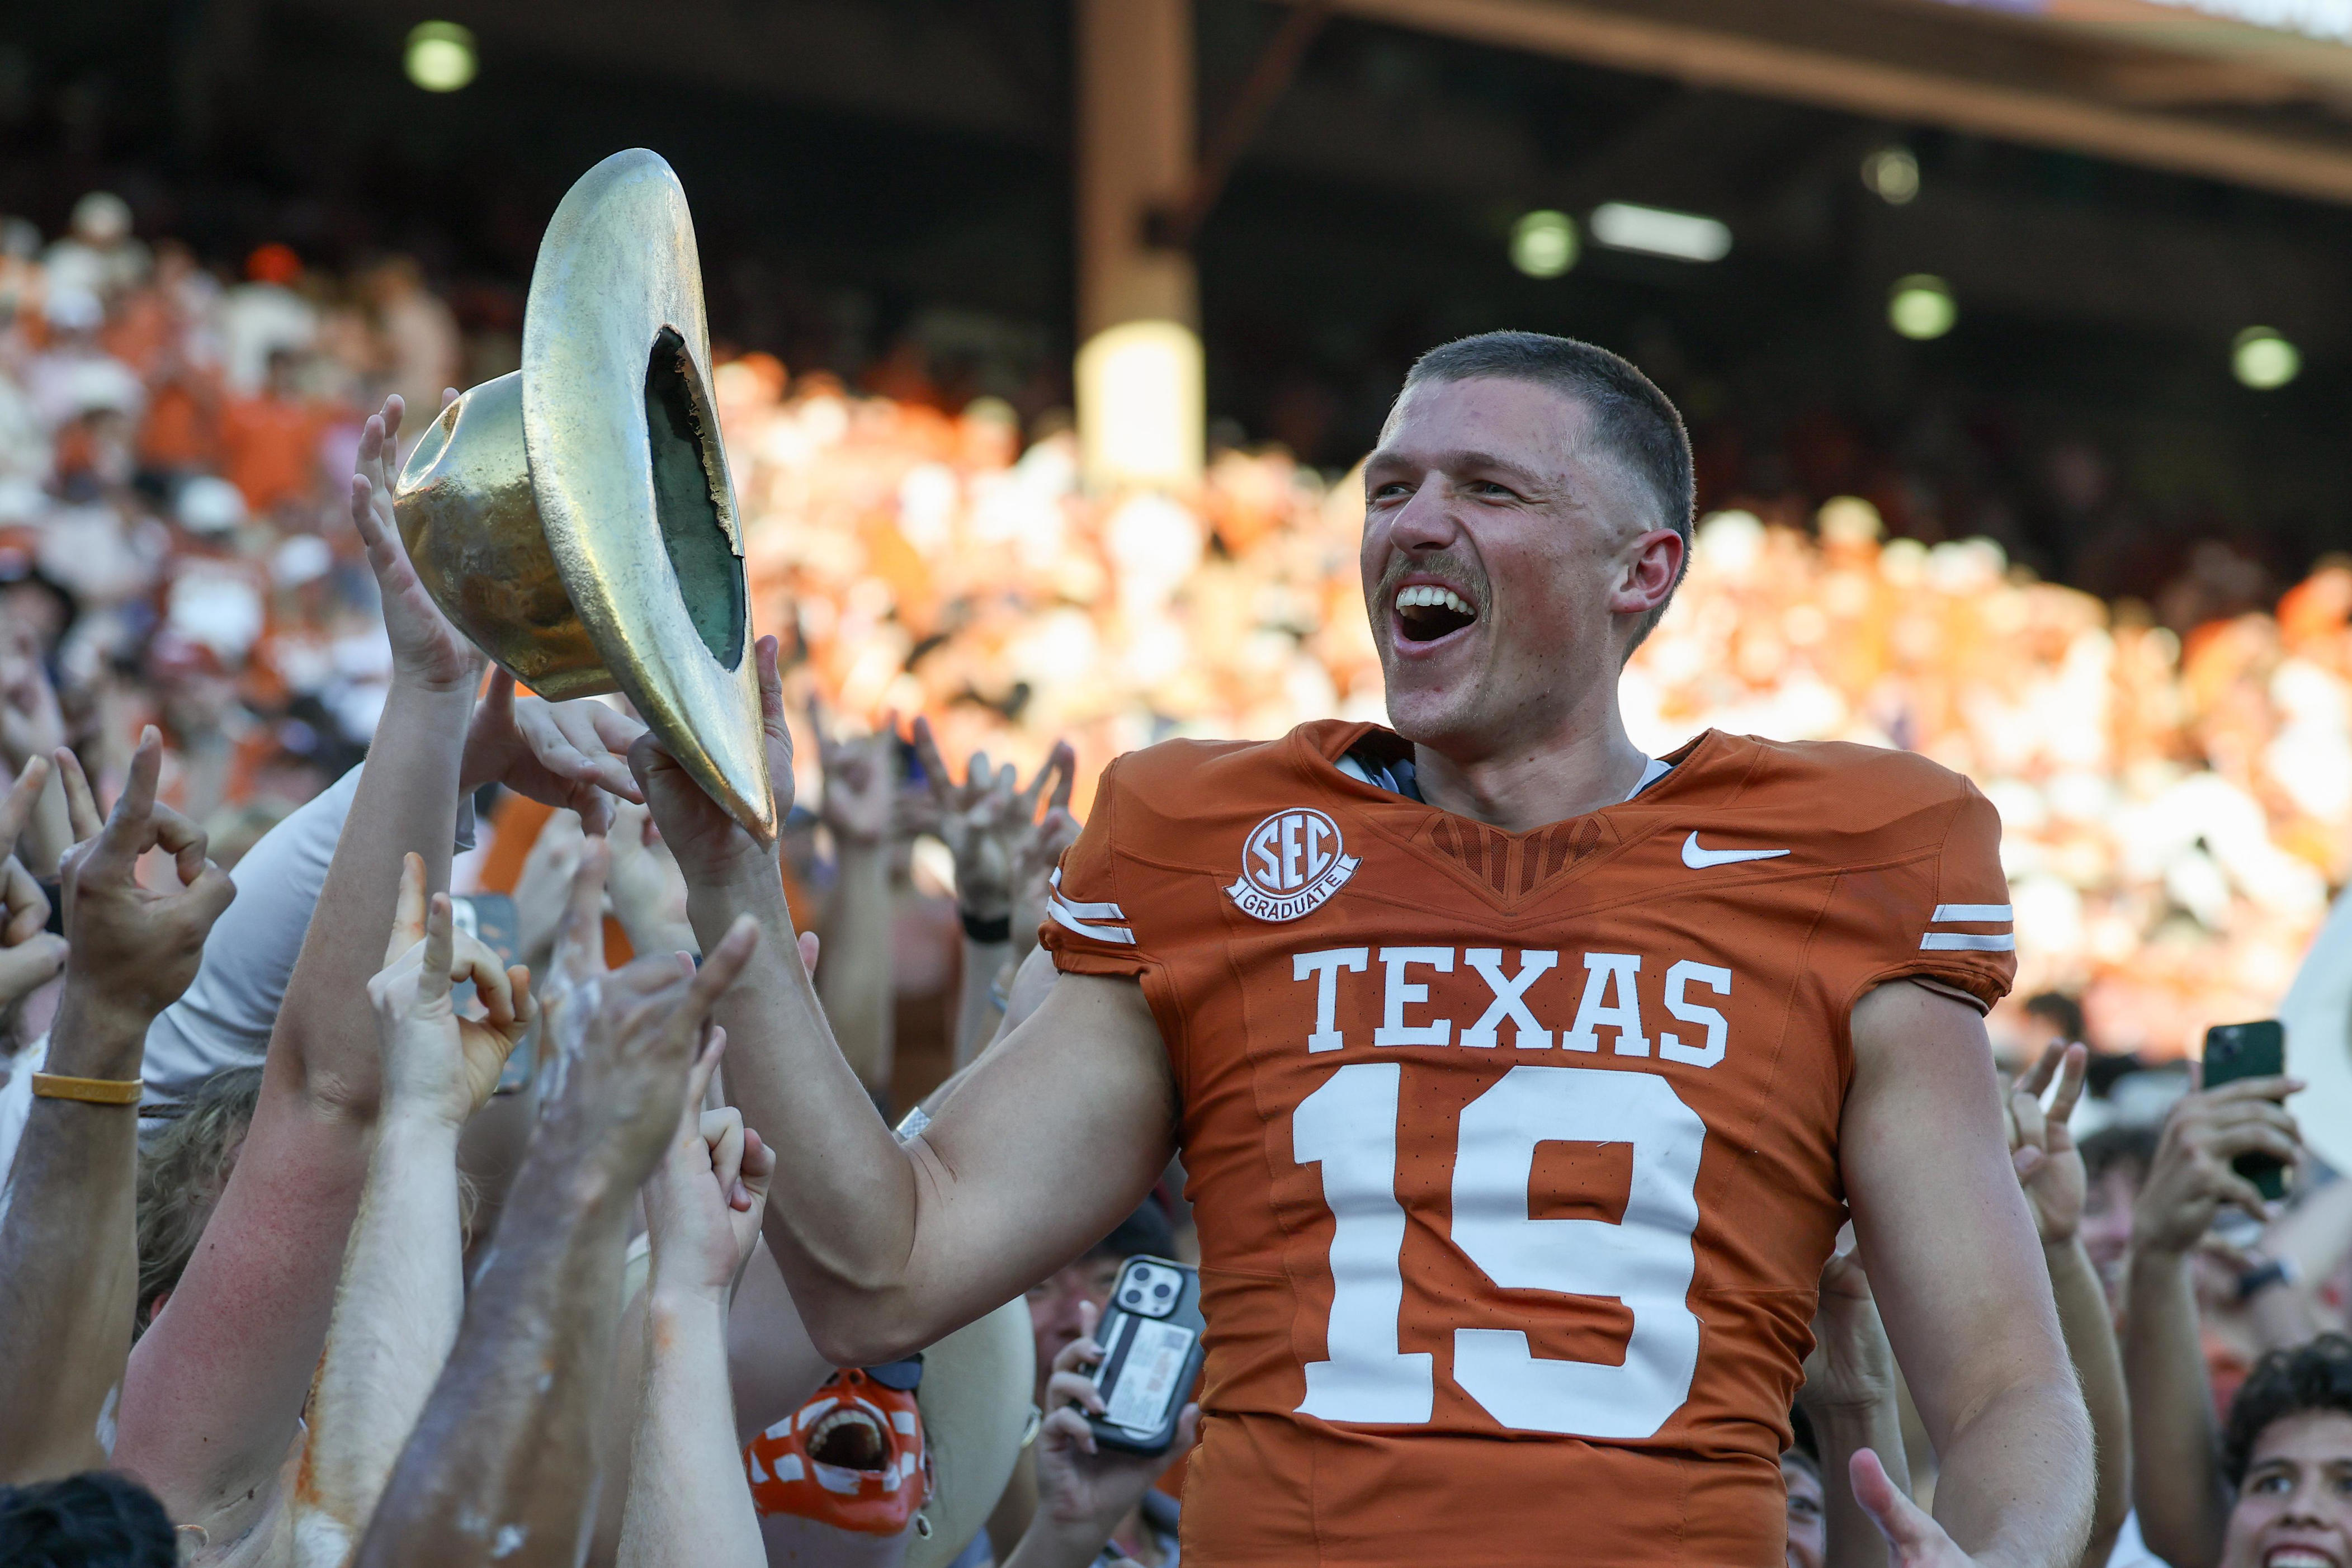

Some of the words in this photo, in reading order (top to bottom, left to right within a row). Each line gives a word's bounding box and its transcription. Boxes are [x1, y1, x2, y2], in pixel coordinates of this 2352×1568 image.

[1244, 873, 1342, 919] GRADUATE
[1251, 815, 1331, 890] SEC
[1293, 946, 1732, 1069] TEXAS
[1293, 1062, 1707, 1438] 19
